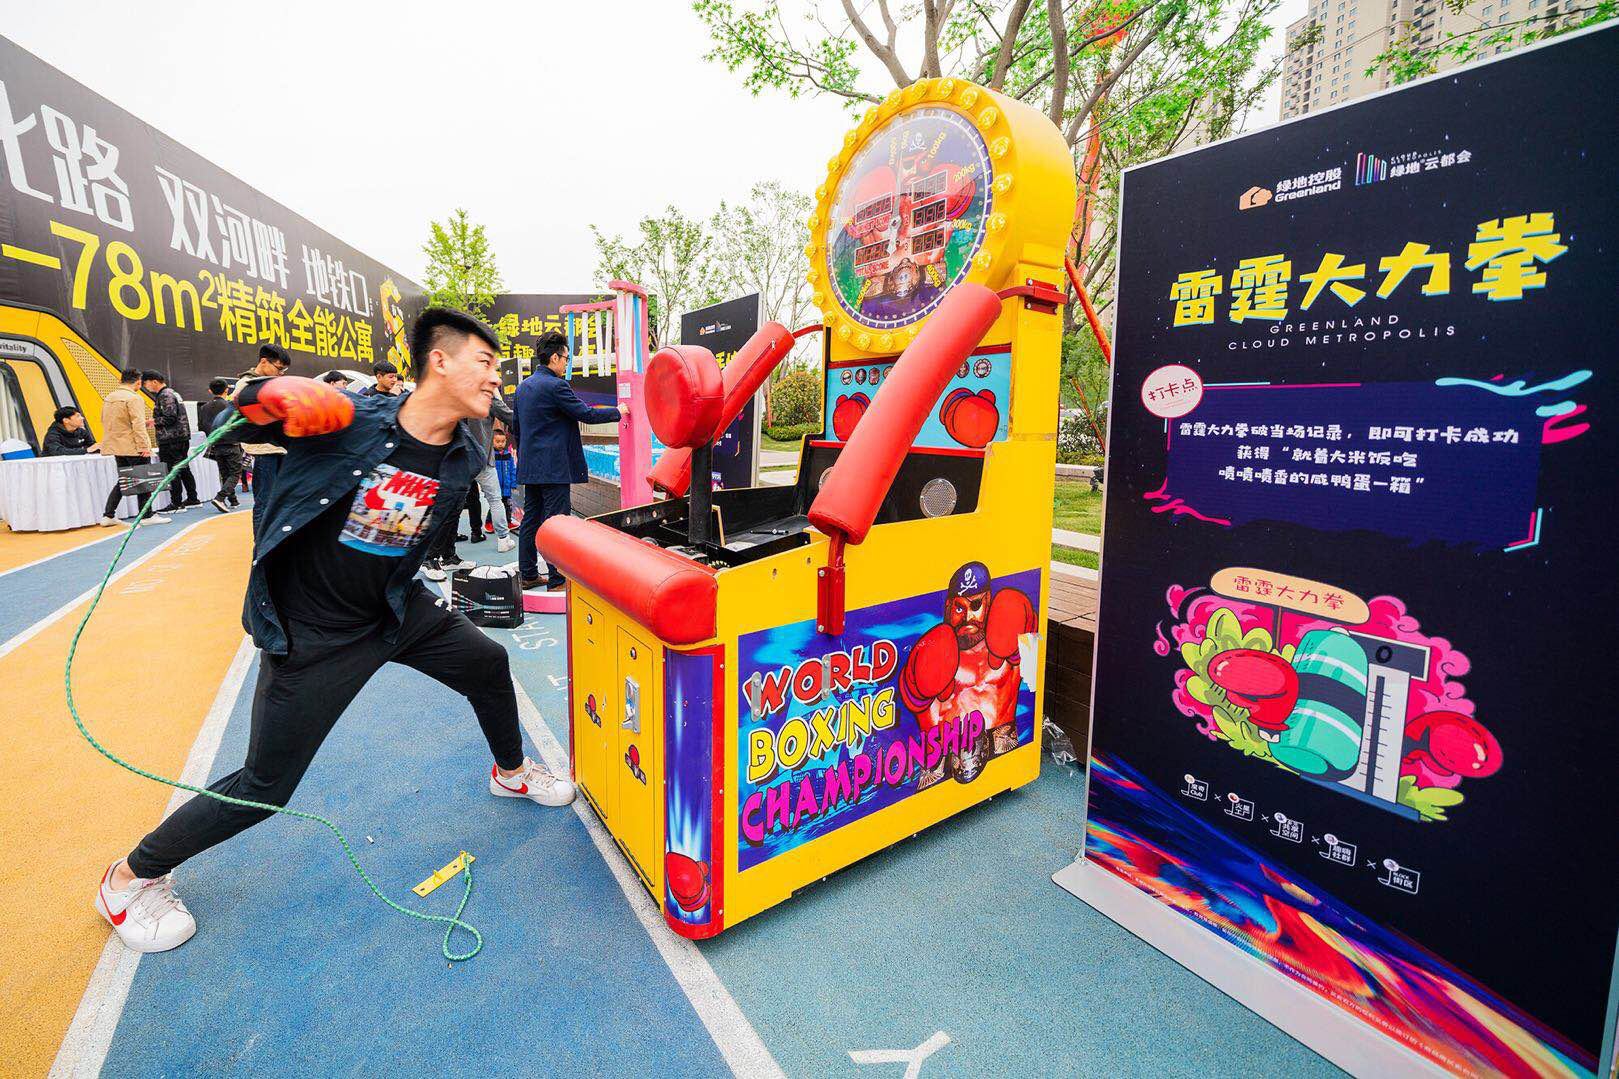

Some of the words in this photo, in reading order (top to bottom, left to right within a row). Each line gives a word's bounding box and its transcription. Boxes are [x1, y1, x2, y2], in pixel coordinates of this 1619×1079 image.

[1274, 180, 1342, 203] Greenland
[1276, 167, 1342, 193] 绿地控股
[155, 165, 290, 289] 双河畔
[302, 244, 371, 317] 地铁口
[1169, 212, 1569, 328] 雷霆大力拳
[1228, 338, 1290, 350] CLOUD
[1305, 326, 1456, 345] METROPOLIS
[1269, 315, 1399, 334] GREENLAND
[1147, 378, 1198, 401] 打卡点
[1233, 575, 1345, 610] 雷霆大力拳
[742, 639, 898, 718] WORLD
[746, 688, 896, 785] BOXING
[741, 710, 985, 847] CHAMPIONSHIP
